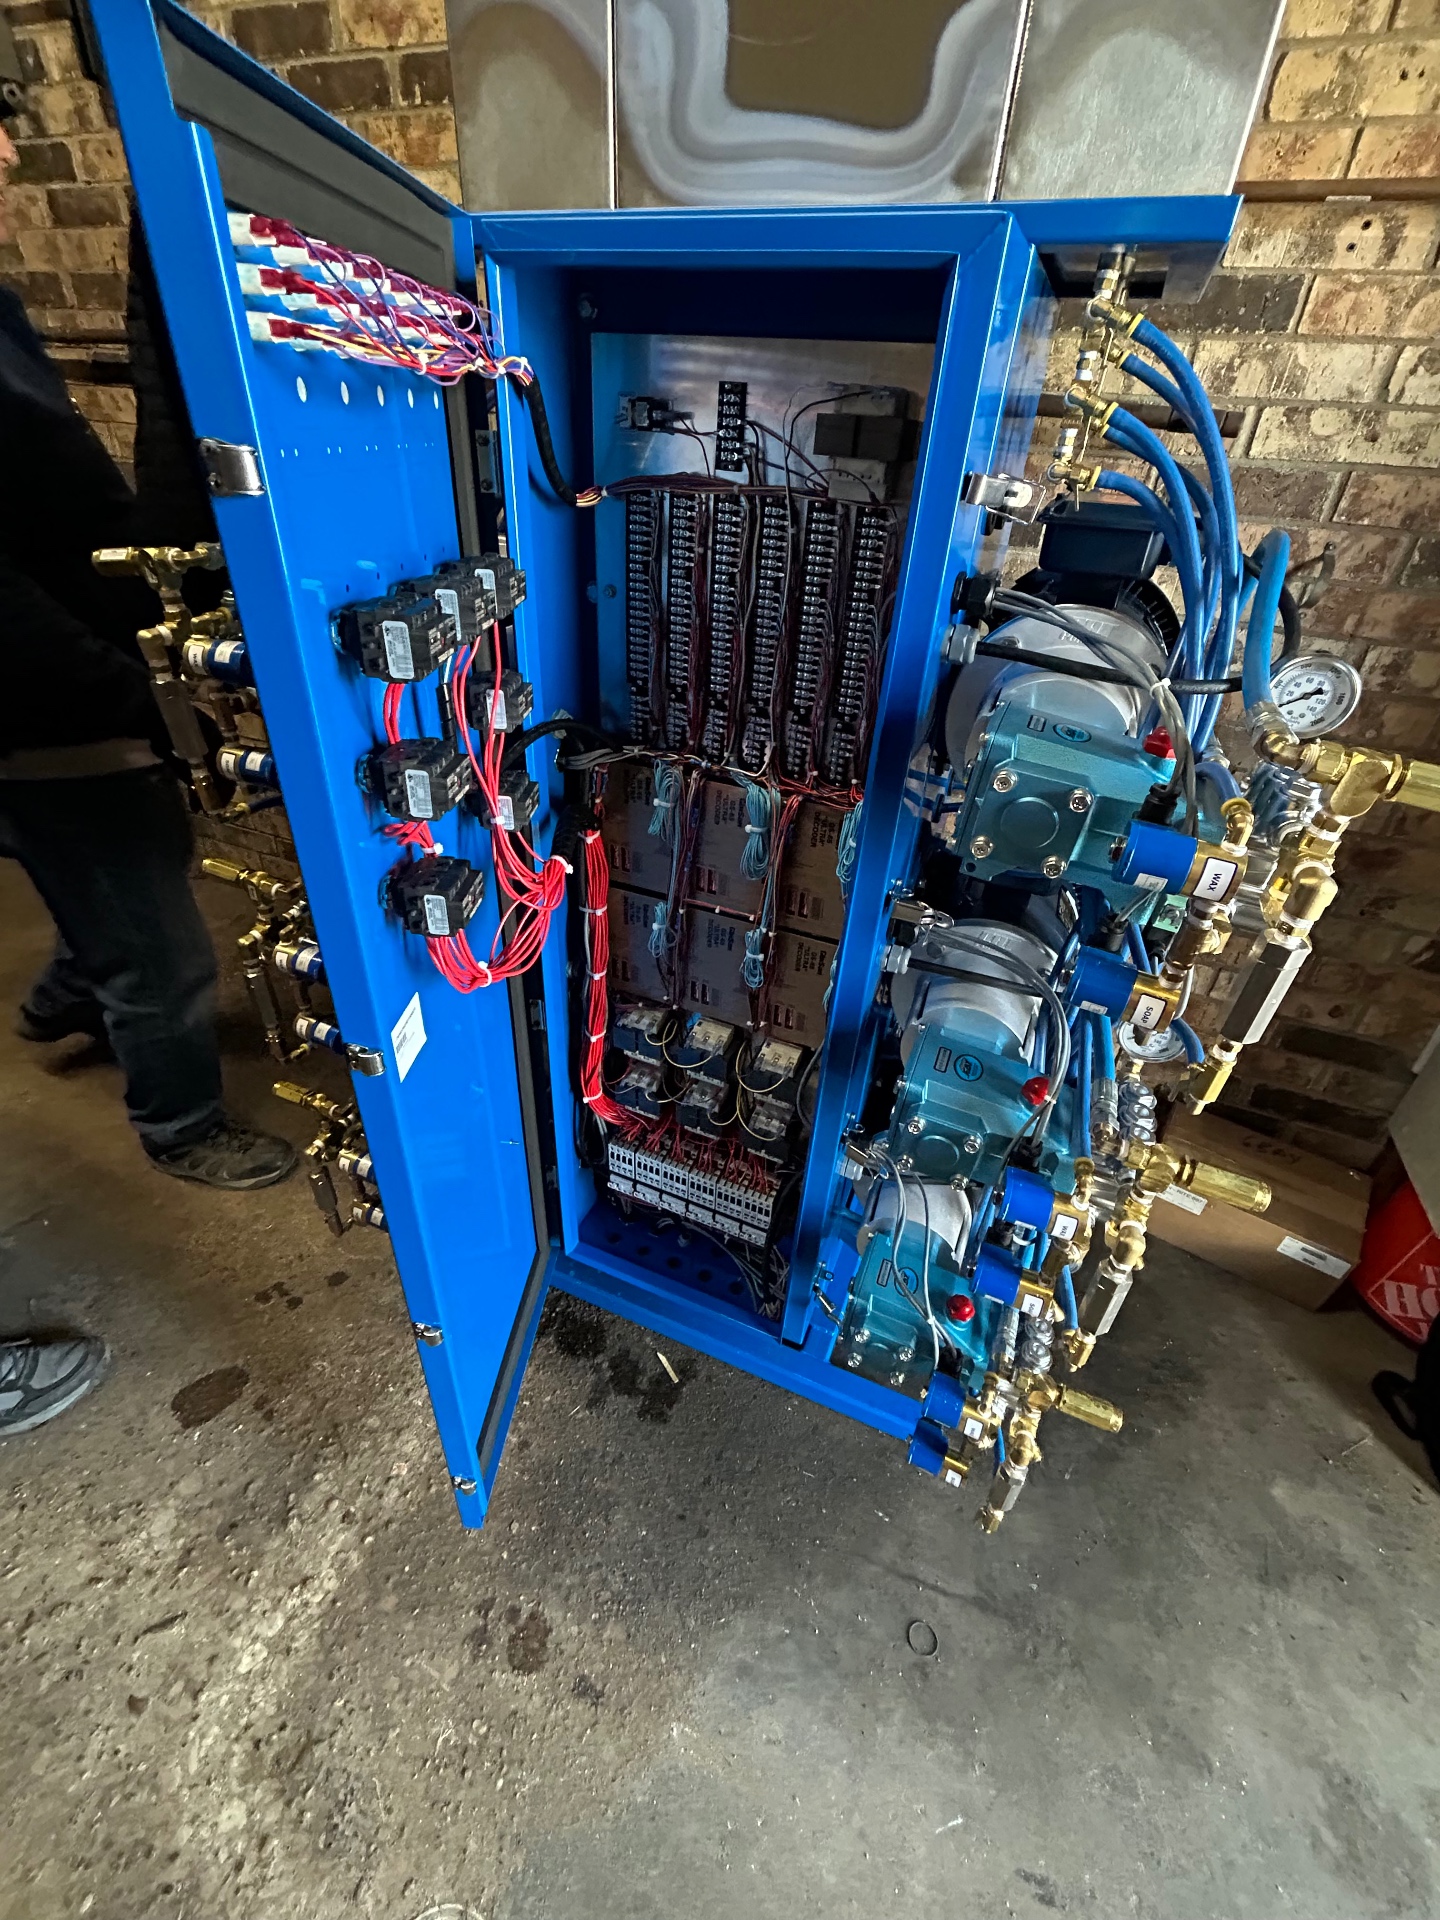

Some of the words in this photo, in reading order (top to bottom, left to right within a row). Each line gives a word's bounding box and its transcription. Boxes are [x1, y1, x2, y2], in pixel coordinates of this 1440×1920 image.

[810, 812, 820, 848] DECODER
[1207, 873, 1222, 892] WAX
[1141, 1006, 1154, 1024] SOAP
